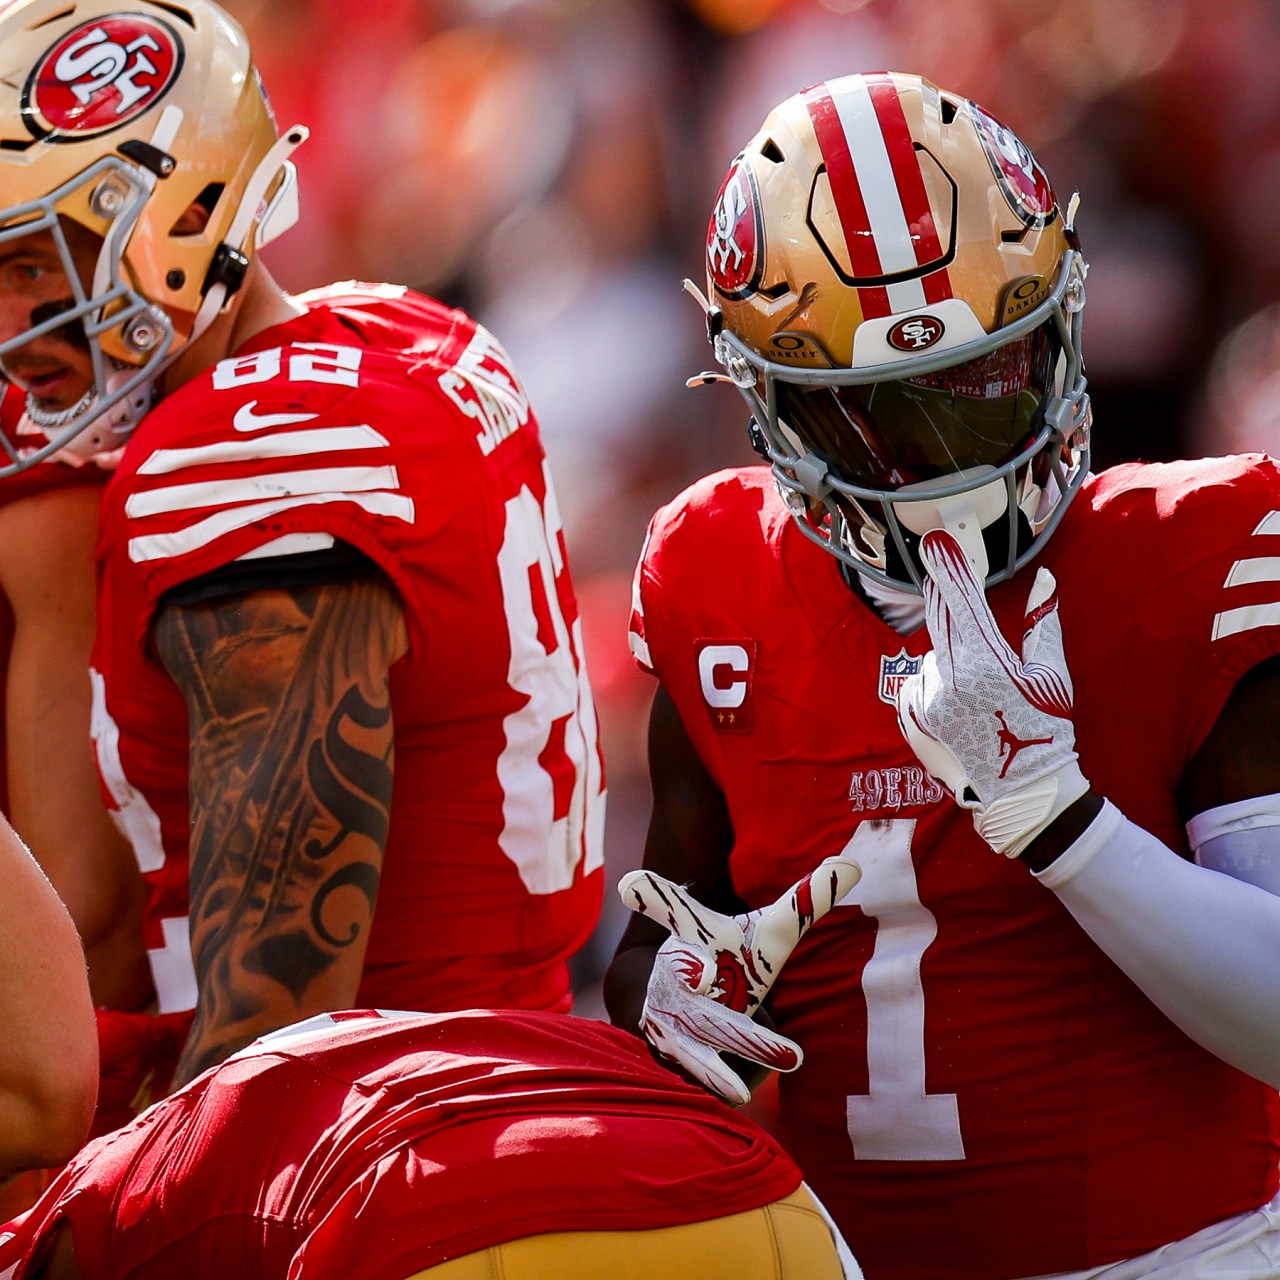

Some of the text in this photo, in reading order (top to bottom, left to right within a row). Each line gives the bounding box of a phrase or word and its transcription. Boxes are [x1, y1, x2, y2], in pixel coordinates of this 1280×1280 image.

[55, 28, 160, 114] SF
[1007, 289, 1048, 315] OAKLEY
[768, 350, 817, 359] OAKLEY
[901, 320, 938, 348] SF
[212, 341, 363, 390] 82
[698, 645, 749, 708] C
[885, 675, 911, 698] NF
[848, 766, 944, 812] 49ERS
[835, 818, 966, 1161] 1
